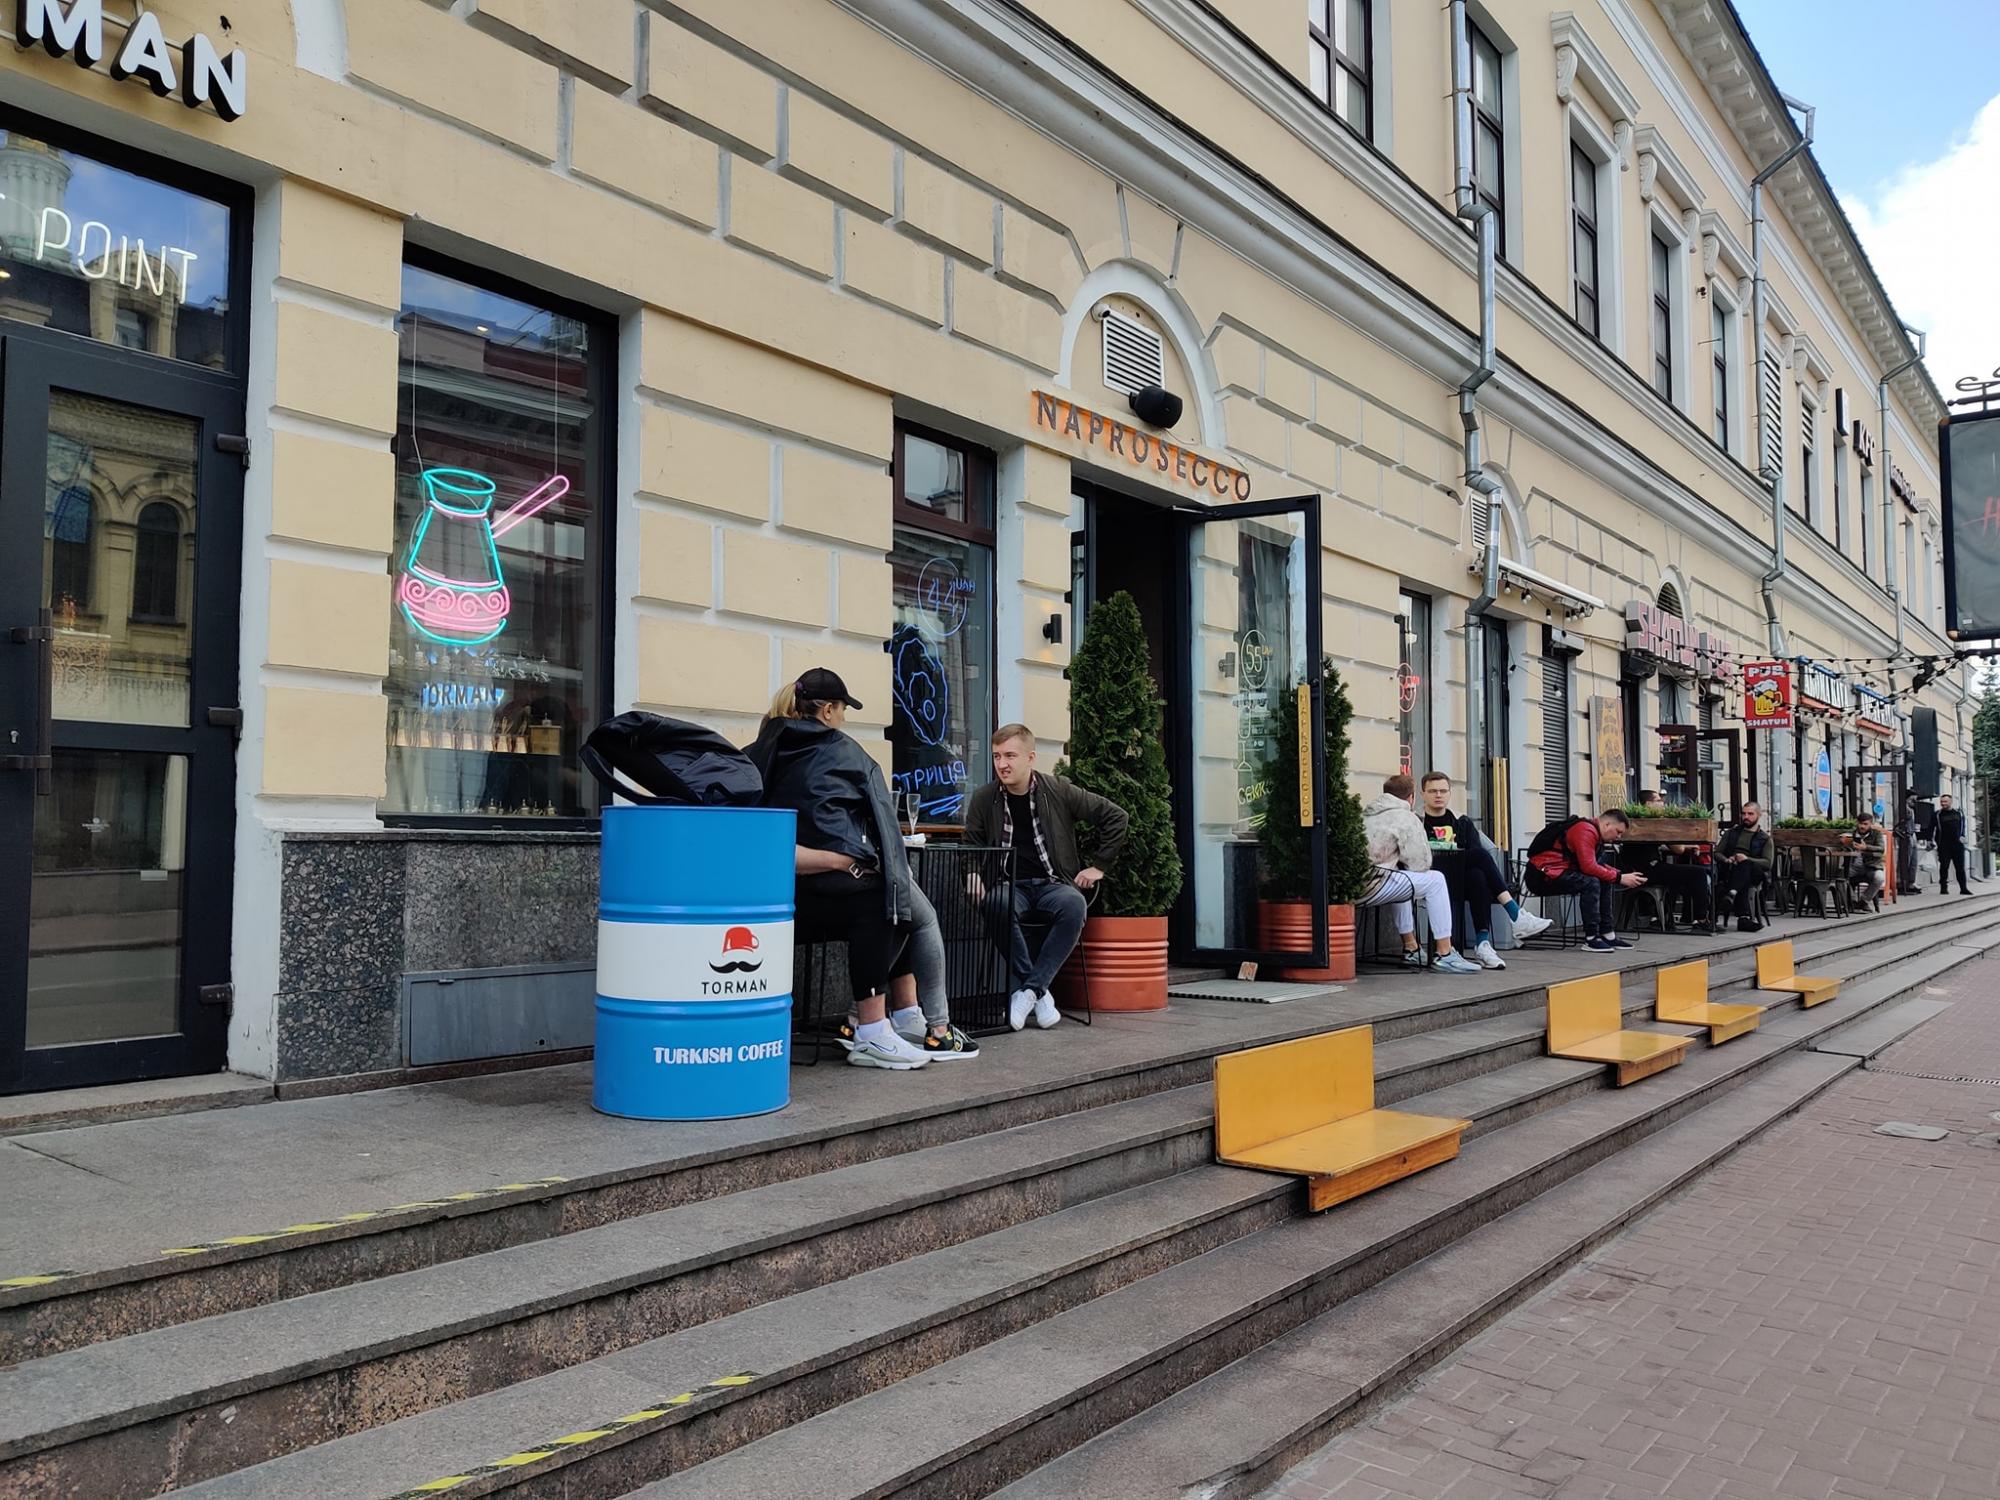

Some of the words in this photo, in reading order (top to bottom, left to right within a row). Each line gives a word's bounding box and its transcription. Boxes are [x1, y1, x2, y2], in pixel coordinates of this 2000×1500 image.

[36, 207, 199, 305] POINT
[1036, 392, 1252, 502] NAPROSECCO
[1857, 418, 1876, 467] KFC
[927, 577, 956, 618] 44
[1637, 600, 1700, 673] SHATUN
[1245, 643, 1263, 673] 55
[1747, 664, 1787, 679] PUB
[1746, 718, 1788, 728] SHATUN
[701, 978, 768, 995] TORMAN
[653, 1046, 733, 1064] TURKISH
[737, 1039, 784, 1062] COFFEE
